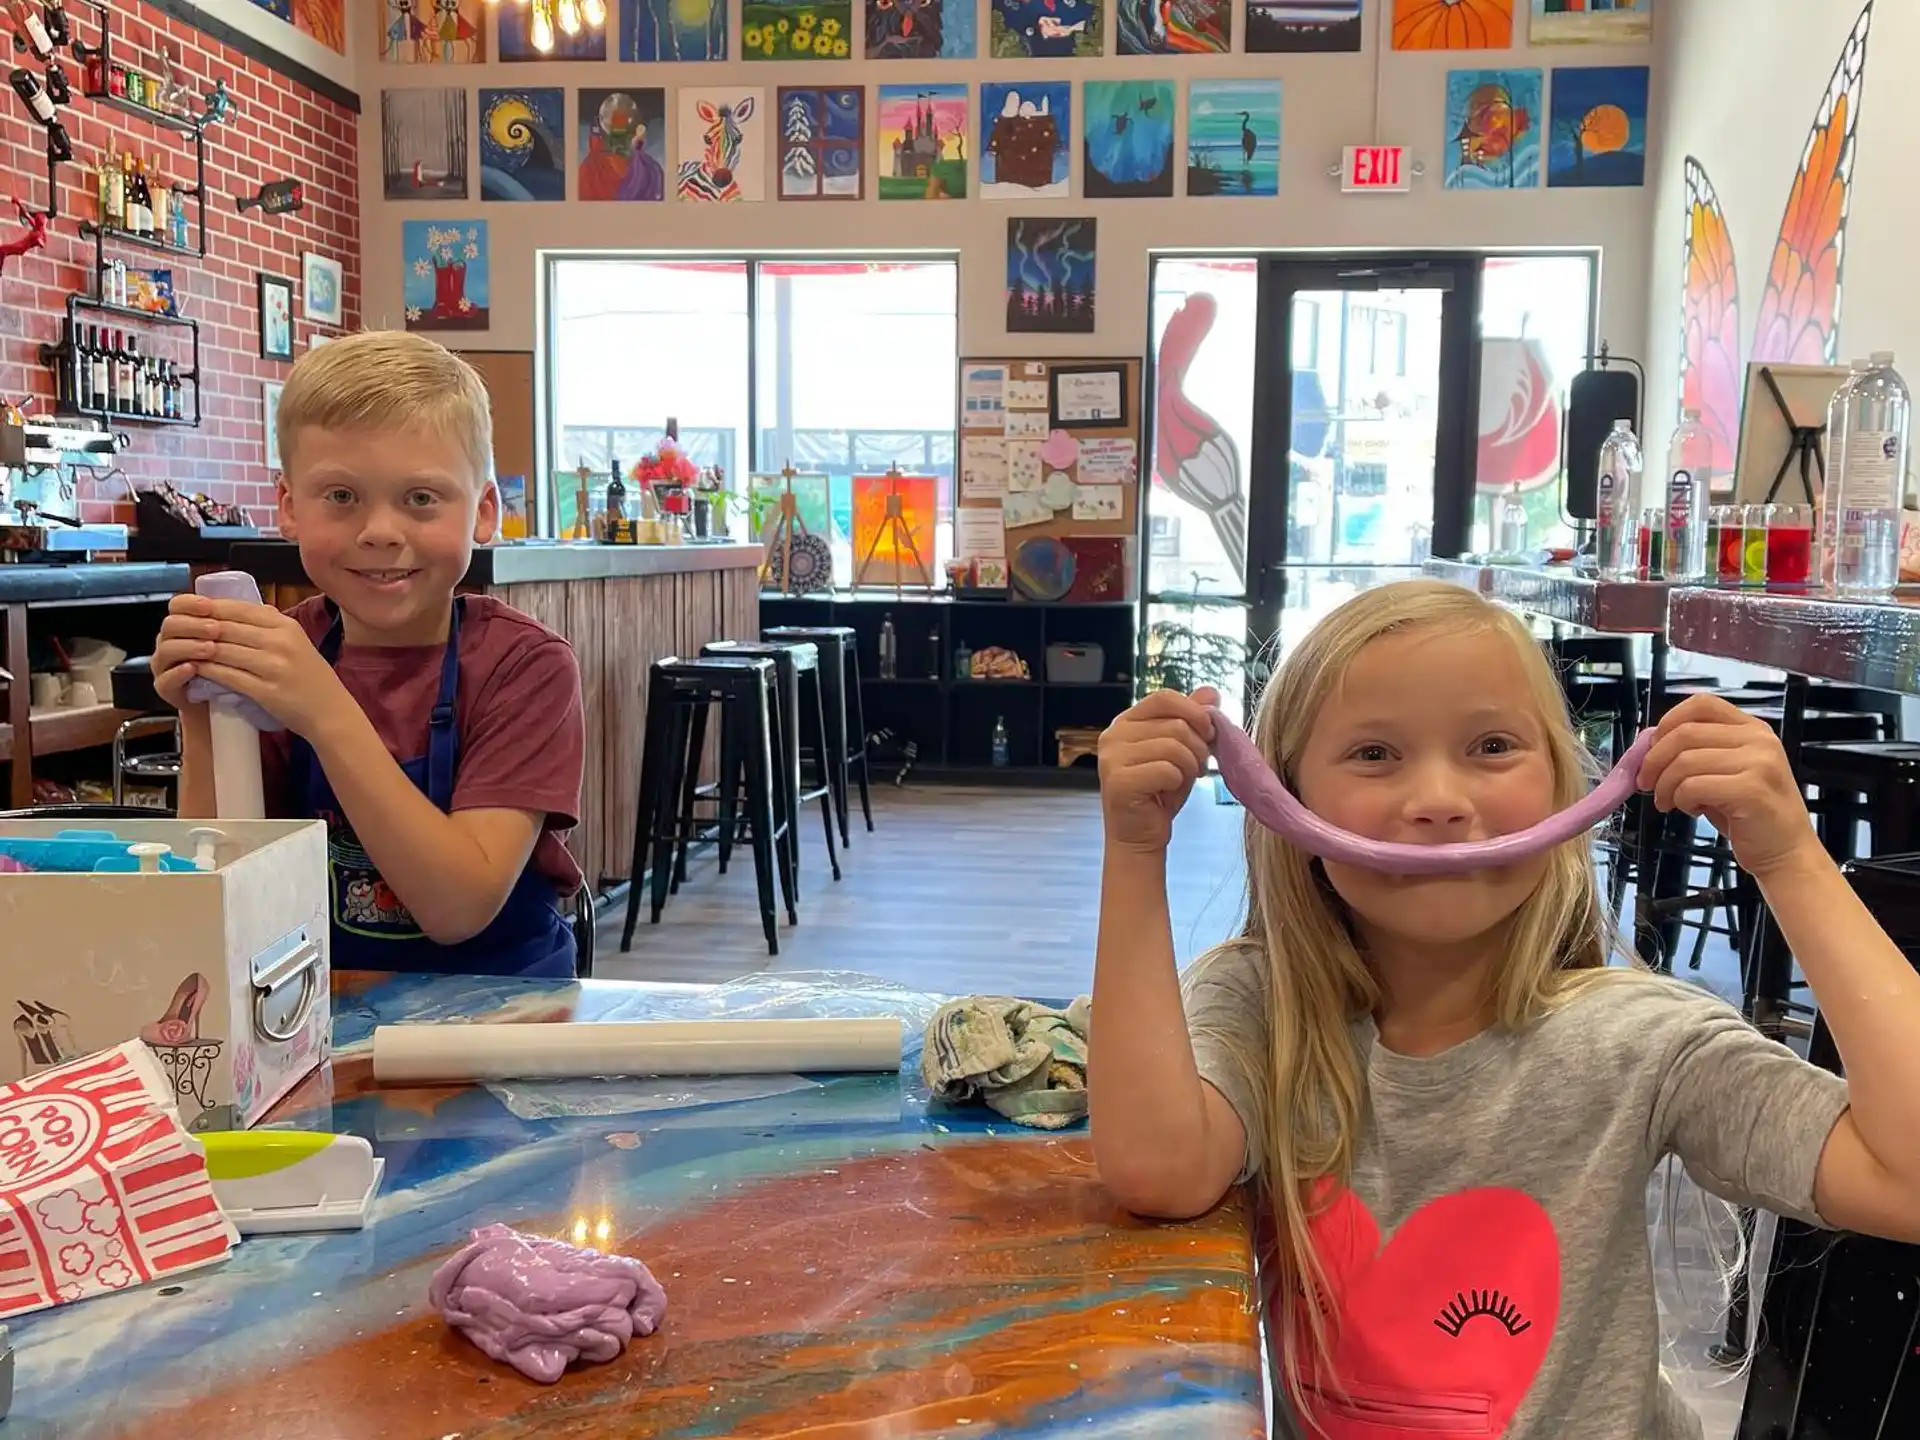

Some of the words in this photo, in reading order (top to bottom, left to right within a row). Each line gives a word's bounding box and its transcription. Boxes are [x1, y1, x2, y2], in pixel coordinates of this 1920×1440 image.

[1353, 147, 1402, 185] EXIT
[1669, 470, 1692, 528] KIND
[0, 1115, 49, 1178] CORN
[30, 1105, 75, 1147] POP
